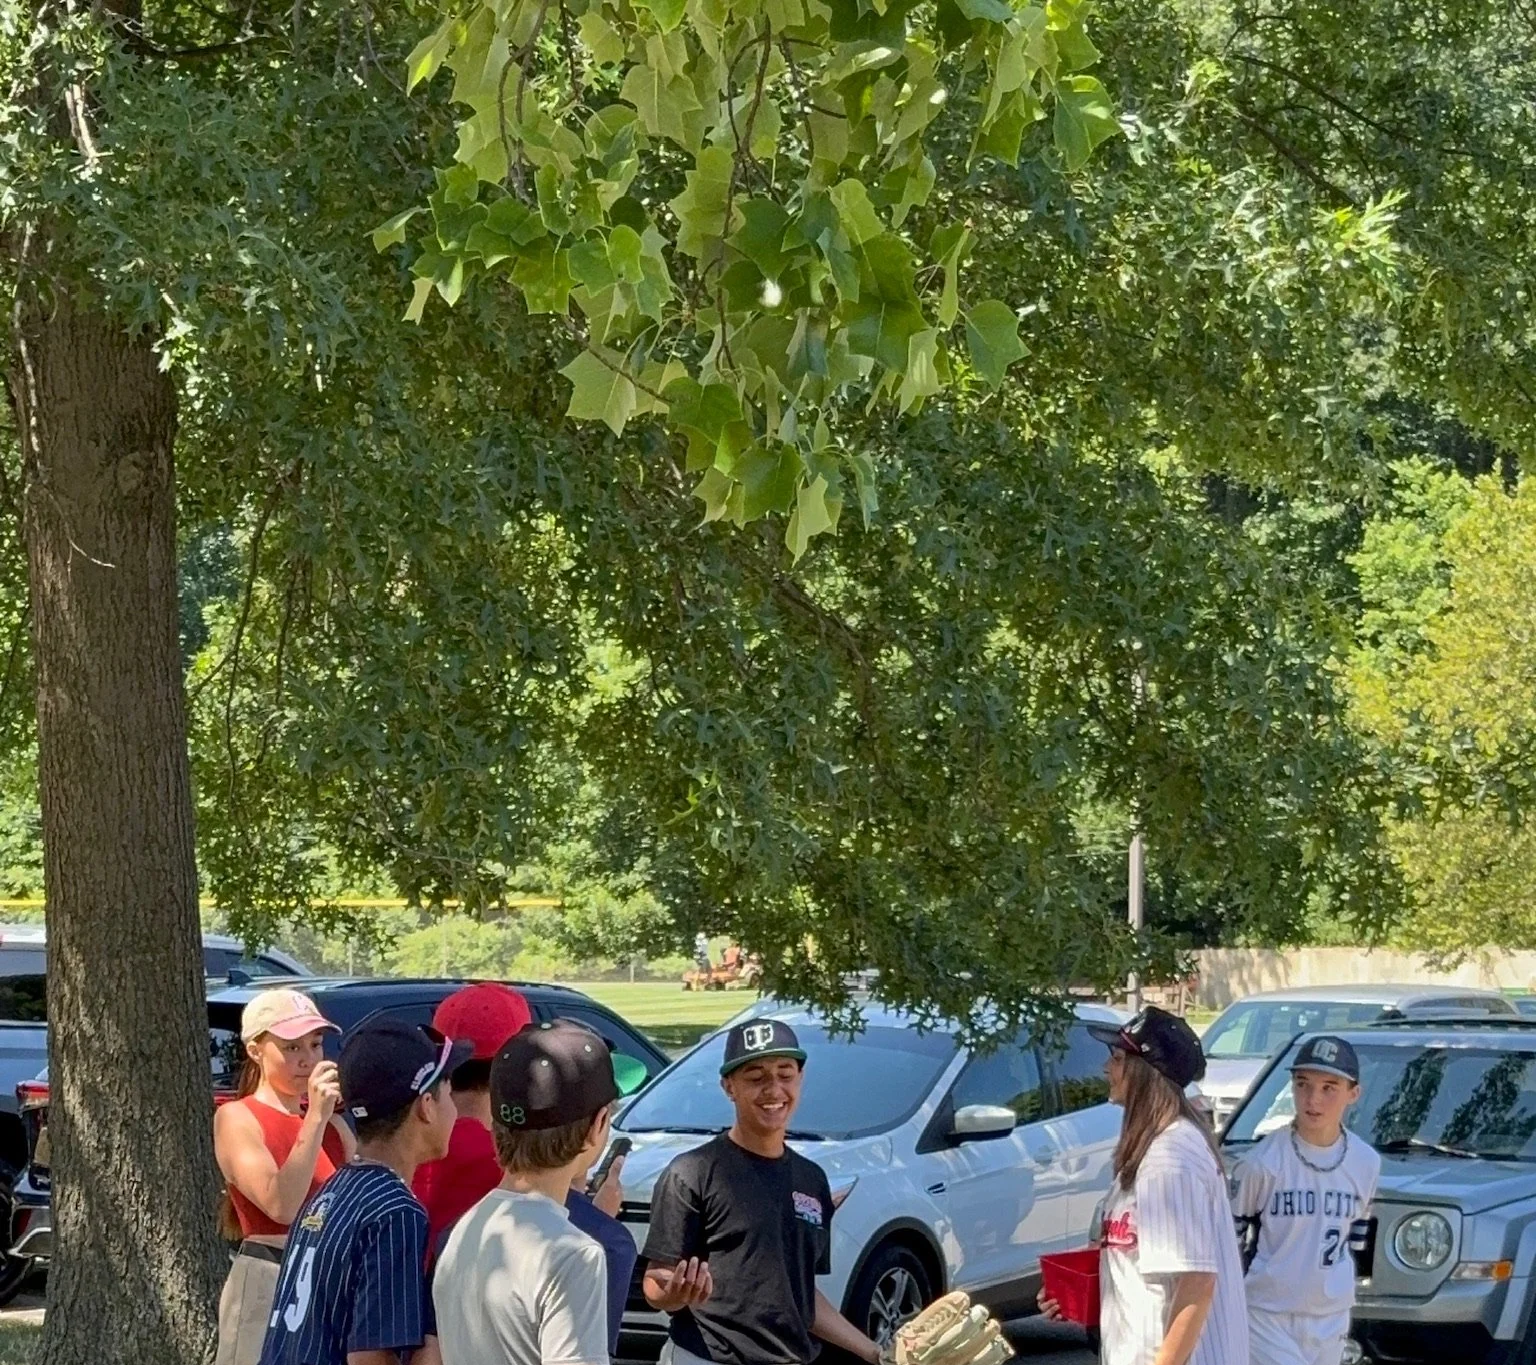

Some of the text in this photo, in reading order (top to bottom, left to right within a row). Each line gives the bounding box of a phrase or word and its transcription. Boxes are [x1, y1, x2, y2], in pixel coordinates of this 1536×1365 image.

[1311, 1040, 1338, 1063] OC
[500, 1103, 526, 1125] 88
[1324, 1191, 1358, 1219] CIT
